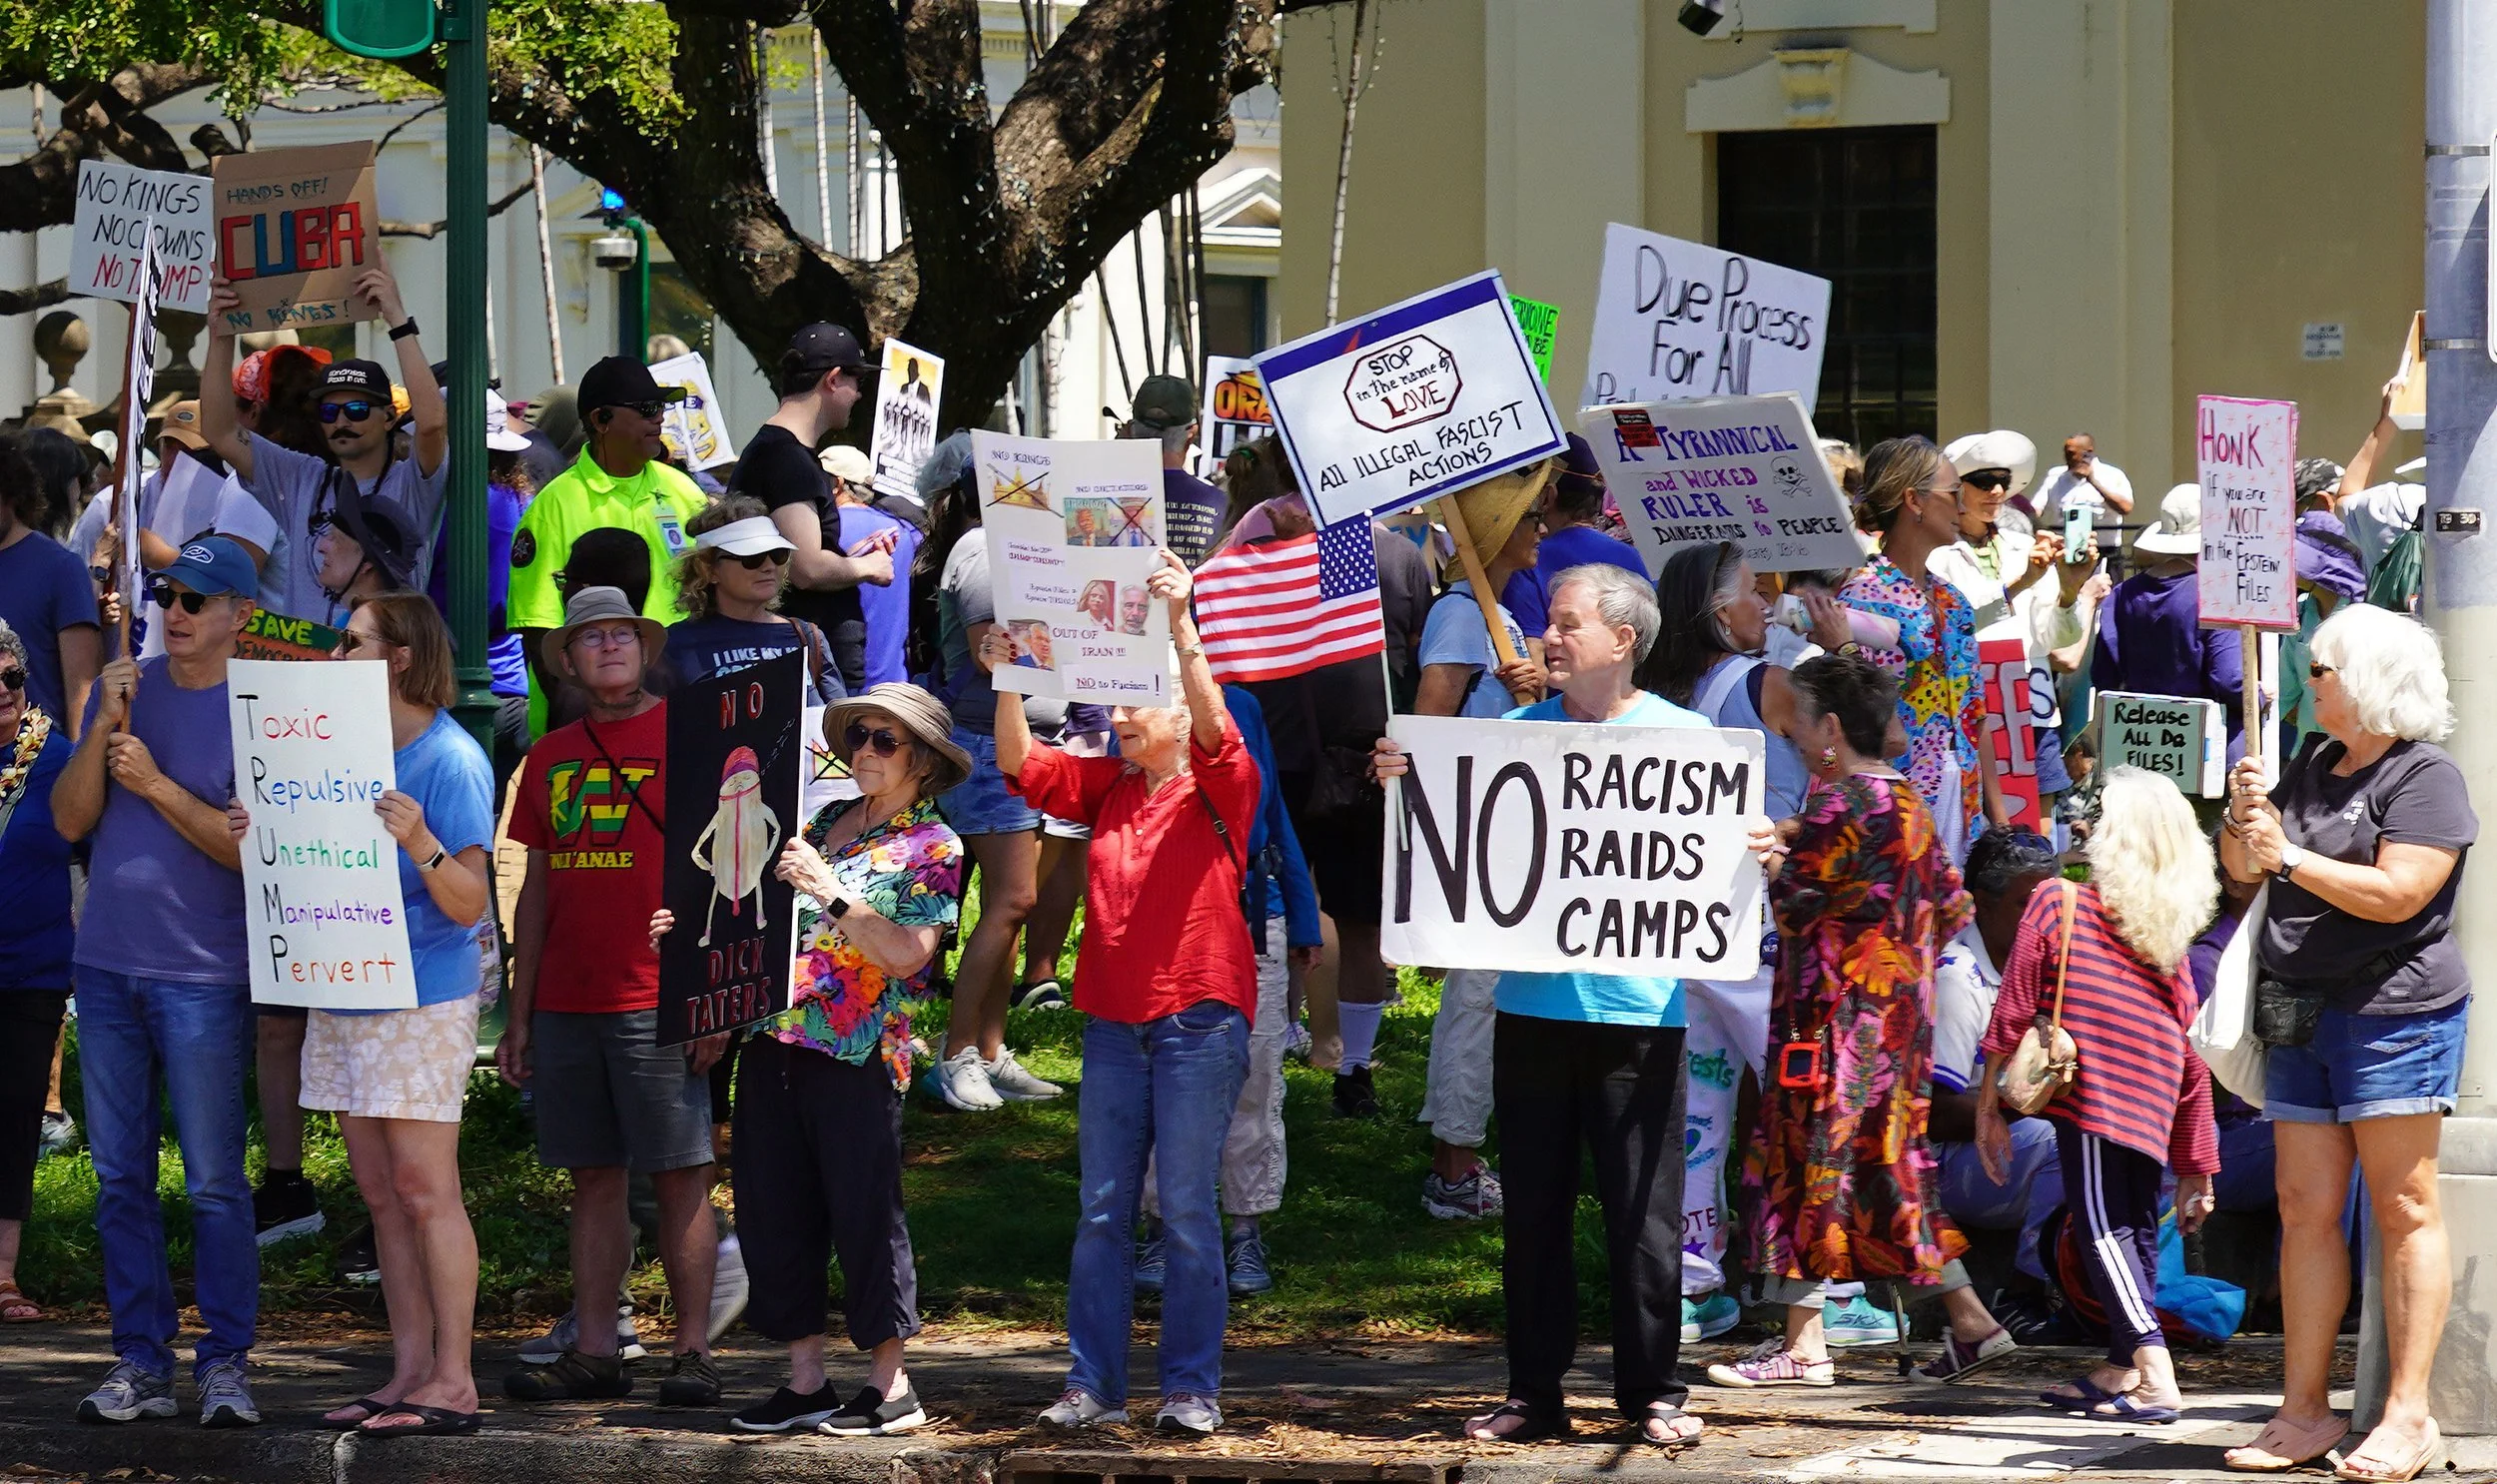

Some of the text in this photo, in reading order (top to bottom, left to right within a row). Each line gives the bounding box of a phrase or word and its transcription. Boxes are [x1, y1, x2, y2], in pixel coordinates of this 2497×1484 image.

[79, 171, 200, 215] NO KINGS
[227, 177, 329, 204] HANDS OFF!
[93, 215, 125, 246] NO
[221, 202, 365, 282] CUBA
[93, 254, 123, 288] NO
[1635, 245, 1814, 351] Due Process
[227, 313, 252, 329] NO
[1368, 345, 1412, 375] STOP
[1651, 320, 1703, 384] For
[1712, 333, 1752, 394] All
[1356, 389, 1370, 401] in
[1400, 364, 1436, 386] name
[1380, 379, 1446, 419] LOVE
[992, 449, 1051, 465] NO KINGS
[1353, 439, 1431, 479] ILLEGAL
[1436, 400, 1523, 449] FASCIST
[1655, 424, 1799, 460] TYRANNICAL
[2201, 407, 2264, 469] HONK
[1408, 441, 1492, 487] ACTIONS
[1646, 467, 1758, 492] and WICKED
[1641, 492, 1769, 520] RULER is
[2222, 487, 2242, 507] you
[2245, 487, 2266, 502] are
[2227, 506, 2267, 534] NOT
[2203, 538, 2213, 560] in
[2217, 537, 2232, 560] the
[245, 609, 313, 645] SAVE
[1053, 627, 1099, 639] OUT OF
[713, 653, 721, 667] I
[723, 648, 760, 663] LIKE
[760, 647, 782, 659] MY
[1077, 678, 1096, 689] NO
[236, 693, 333, 740] Toxic
[719, 681, 765, 730] NO
[2113, 703, 2191, 727] Release
[2122, 729, 2150, 746] ALL
[2126, 751, 2184, 777] FILES!
[251, 756, 384, 814] Repulsive
[1562, 752, 1749, 816] RACISM
[256, 825, 379, 869] Unethical
[1394, 752, 1548, 928] NO
[1559, 828, 1705, 882] RAIDS
[263, 883, 394, 931] Manipulative
[1556, 897, 1731, 964] CAMPS
[270, 935, 396, 984] Pervert
[708, 935, 766, 985] DICK
[686, 976, 772, 1035] TATERS
